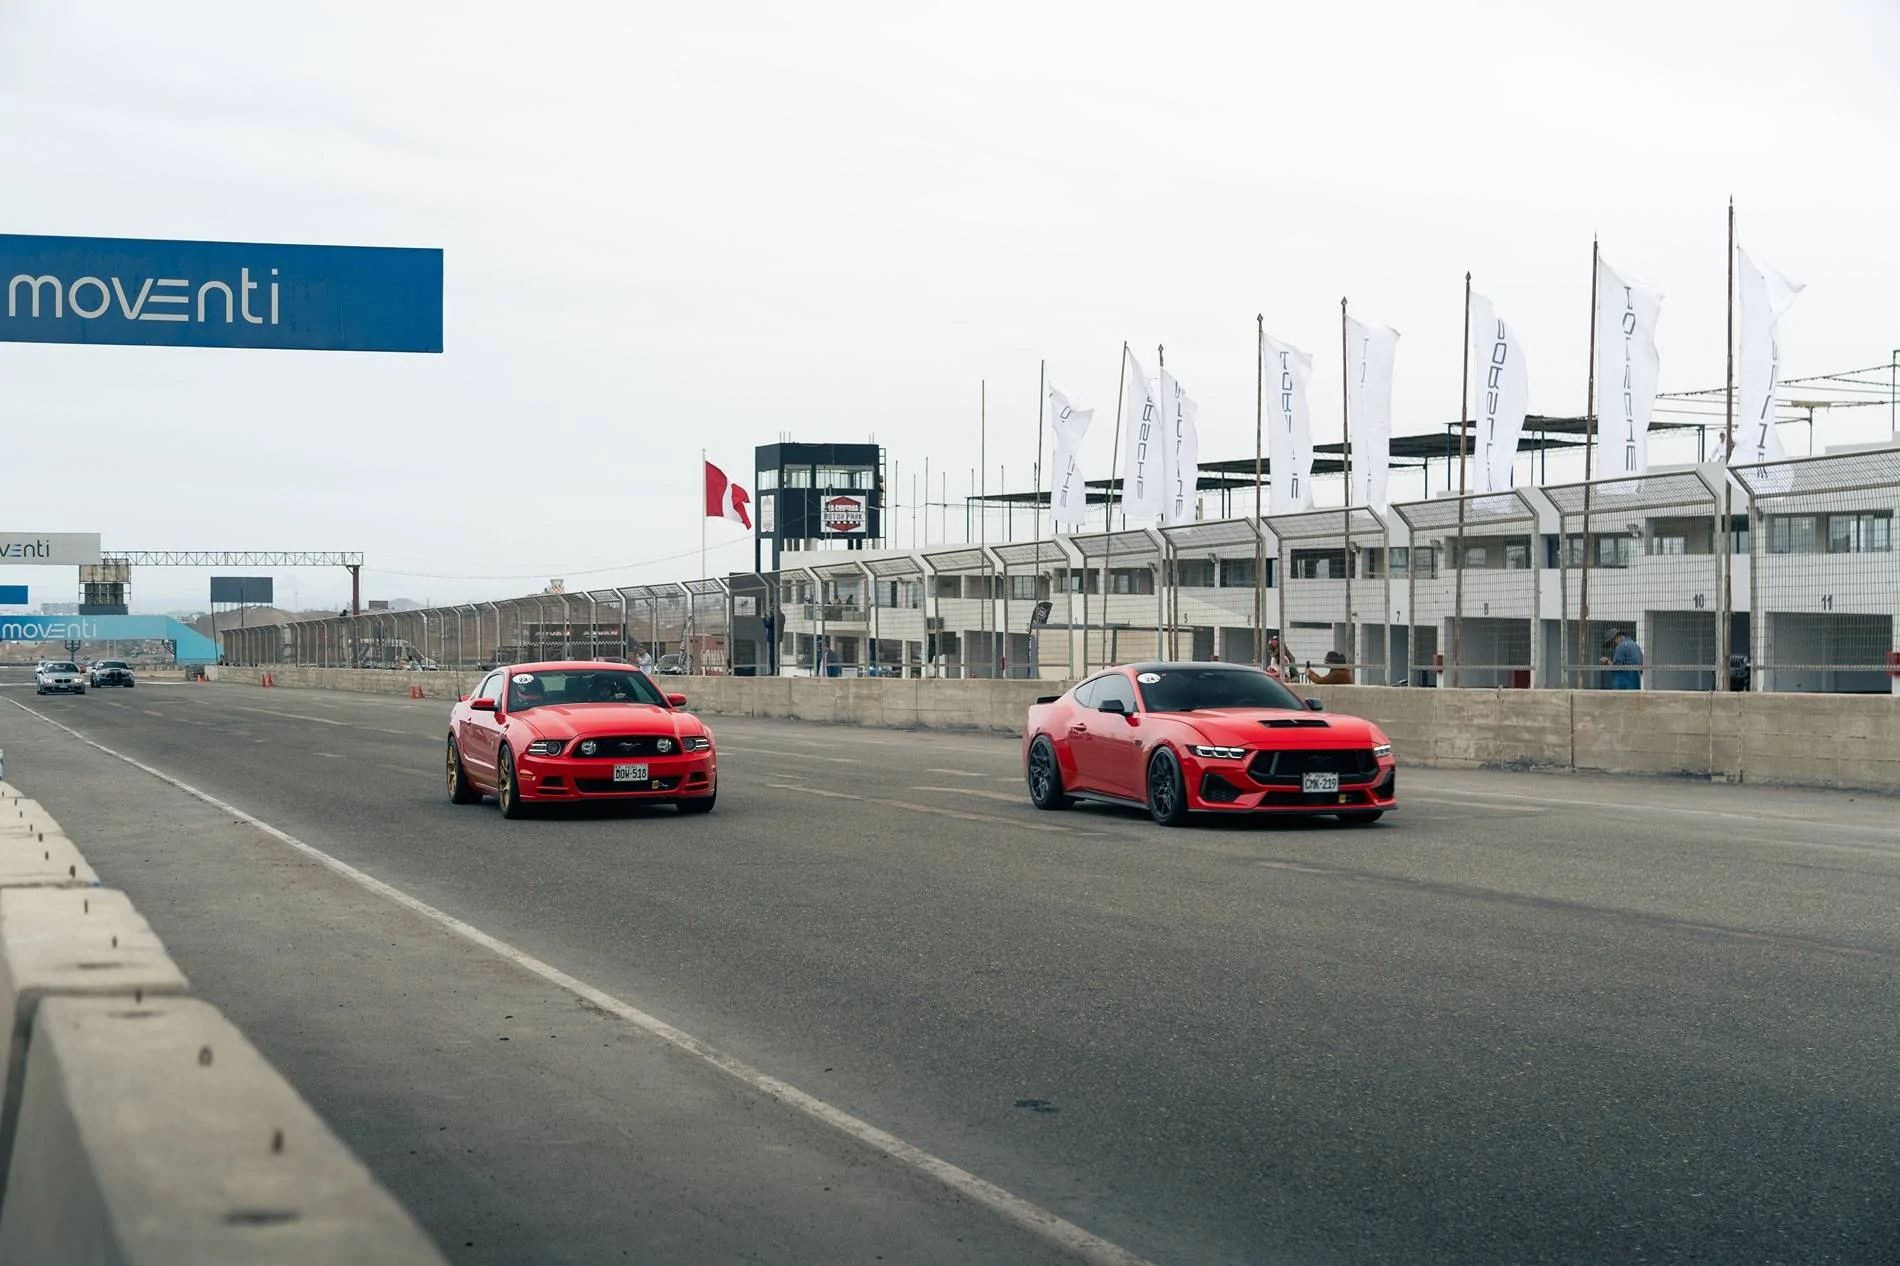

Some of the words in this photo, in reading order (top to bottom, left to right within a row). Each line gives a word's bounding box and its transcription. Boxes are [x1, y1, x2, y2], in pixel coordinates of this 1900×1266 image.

[8, 267, 279, 325] moventi
[823, 512, 845, 520] MOTOR
[846, 512, 863, 520] PARK
[1693, 593, 1705, 609] 10
[1821, 594, 1832, 611] 11
[1305, 777, 1337, 790] CMK-219
